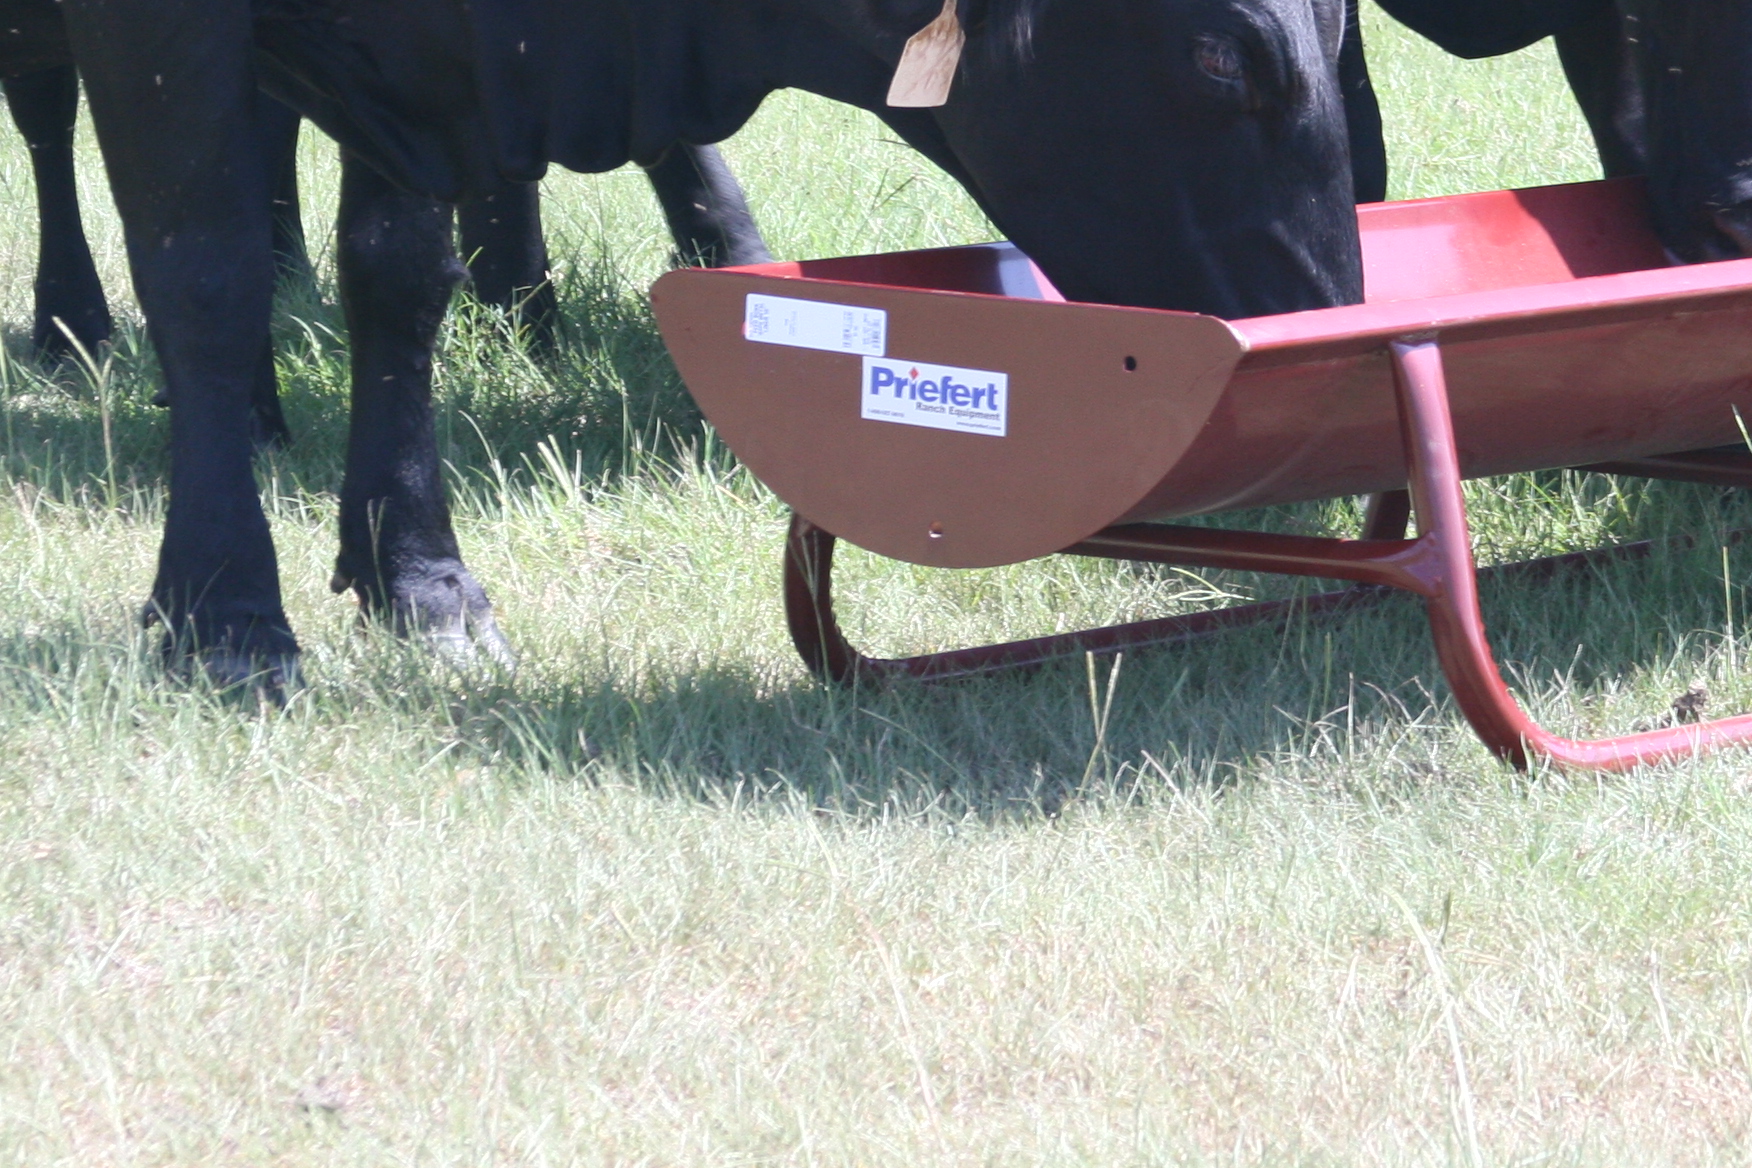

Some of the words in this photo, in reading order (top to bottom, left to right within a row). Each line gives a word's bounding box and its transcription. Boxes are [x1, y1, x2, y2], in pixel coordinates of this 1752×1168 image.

[869, 366, 999, 411] Priefert
[915, 401, 946, 414] Ranch
[948, 405, 1001, 421] Equipment
